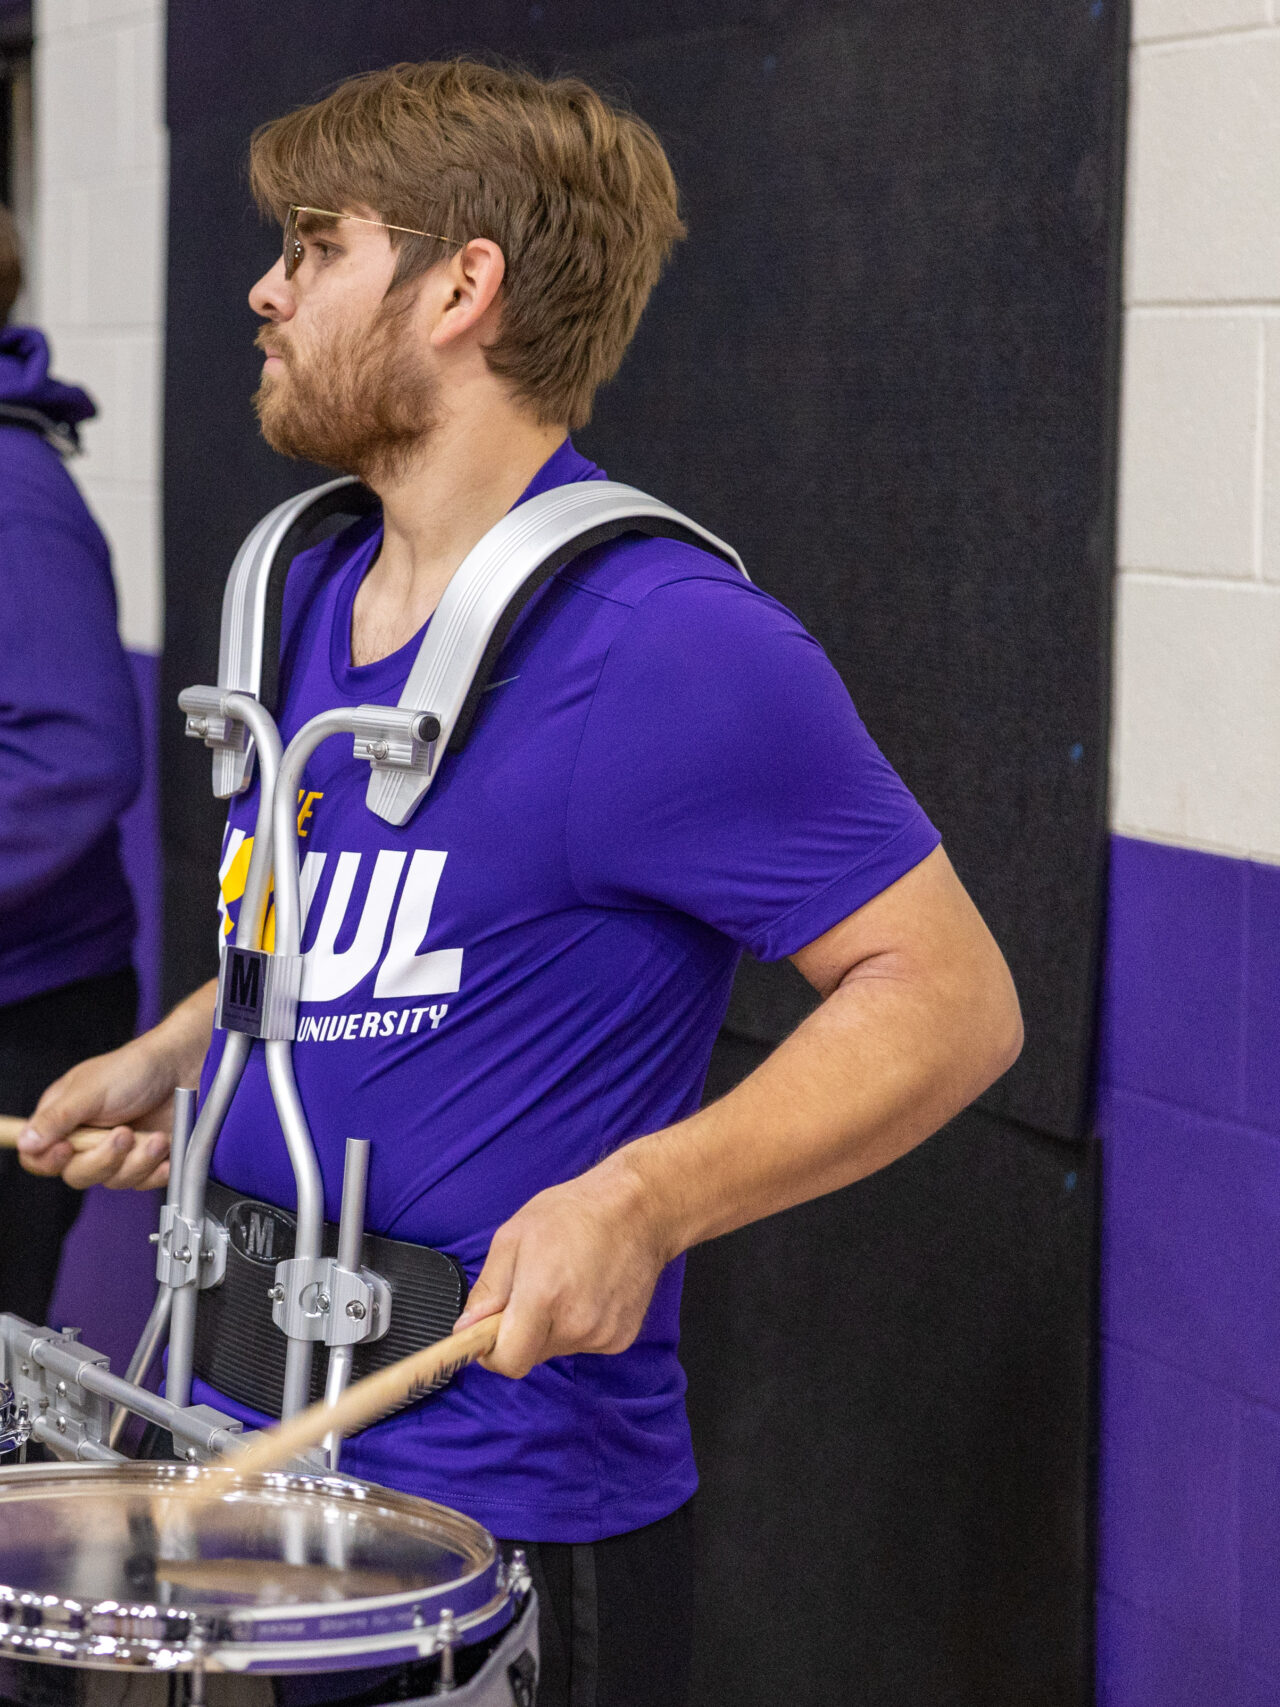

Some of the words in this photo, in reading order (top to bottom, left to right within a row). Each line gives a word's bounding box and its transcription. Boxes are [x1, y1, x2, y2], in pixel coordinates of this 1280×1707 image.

[229, 952, 261, 1009] M
[296, 1003, 449, 1043] UNIVERSITY
[247, 1212, 275, 1258] M
